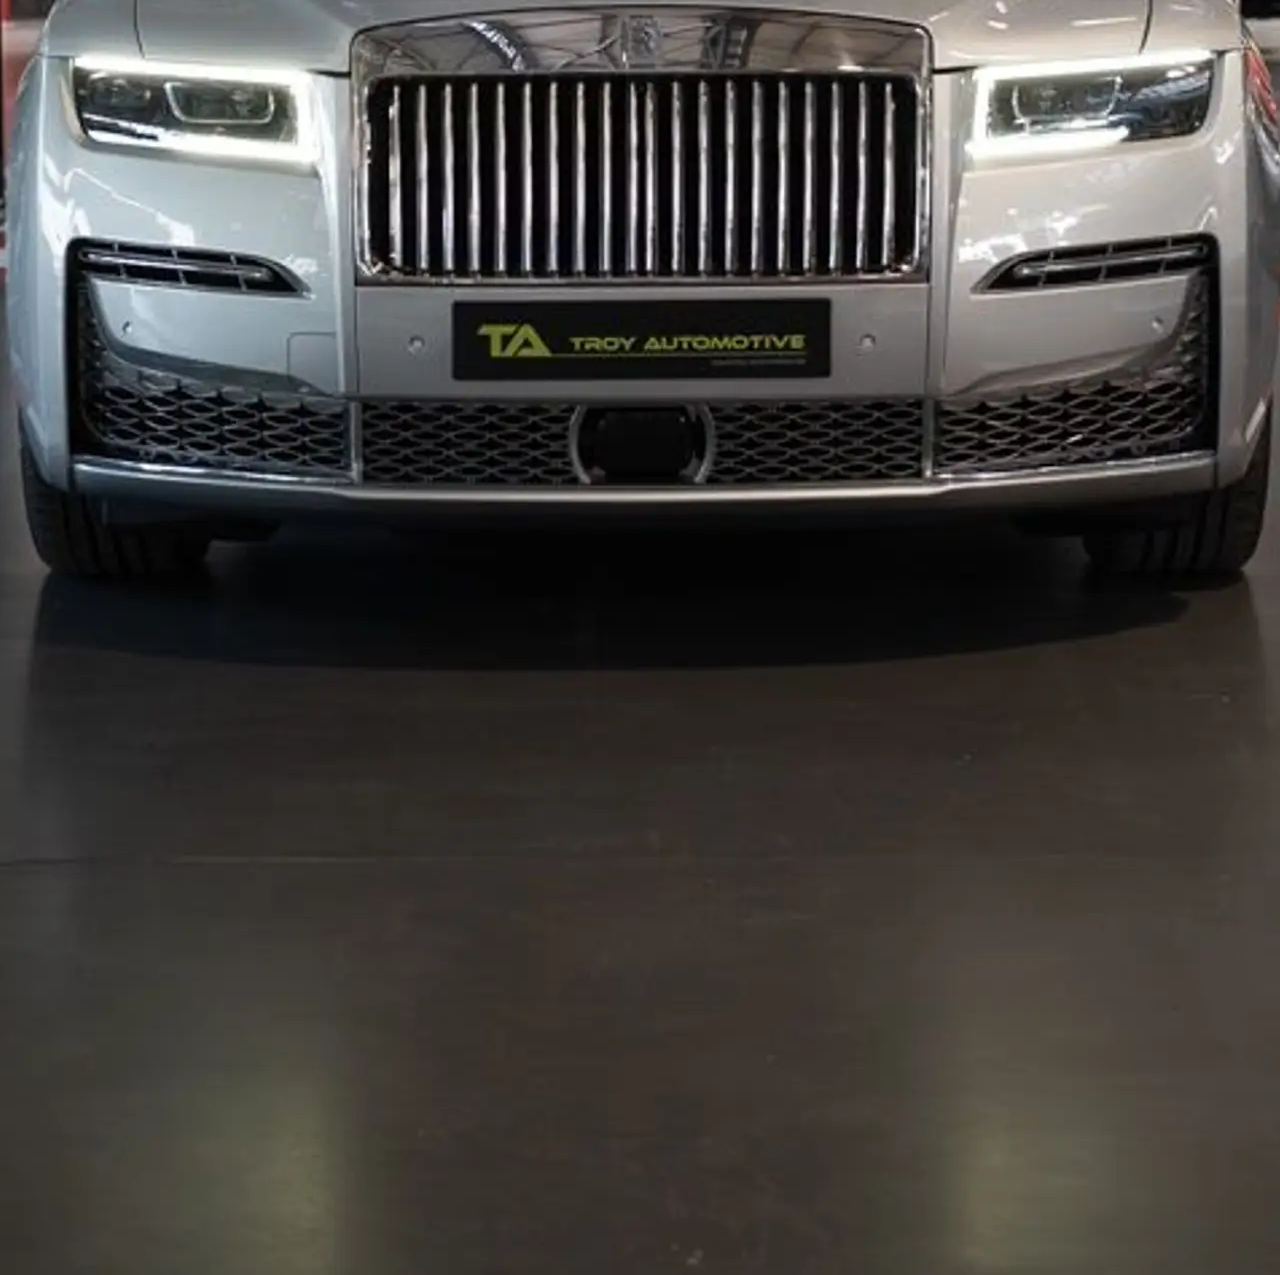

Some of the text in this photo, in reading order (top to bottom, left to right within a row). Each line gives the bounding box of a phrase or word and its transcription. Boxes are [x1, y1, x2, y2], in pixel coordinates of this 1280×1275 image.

[477, 324, 806, 358] TA TROY AUTOMOTIVE
